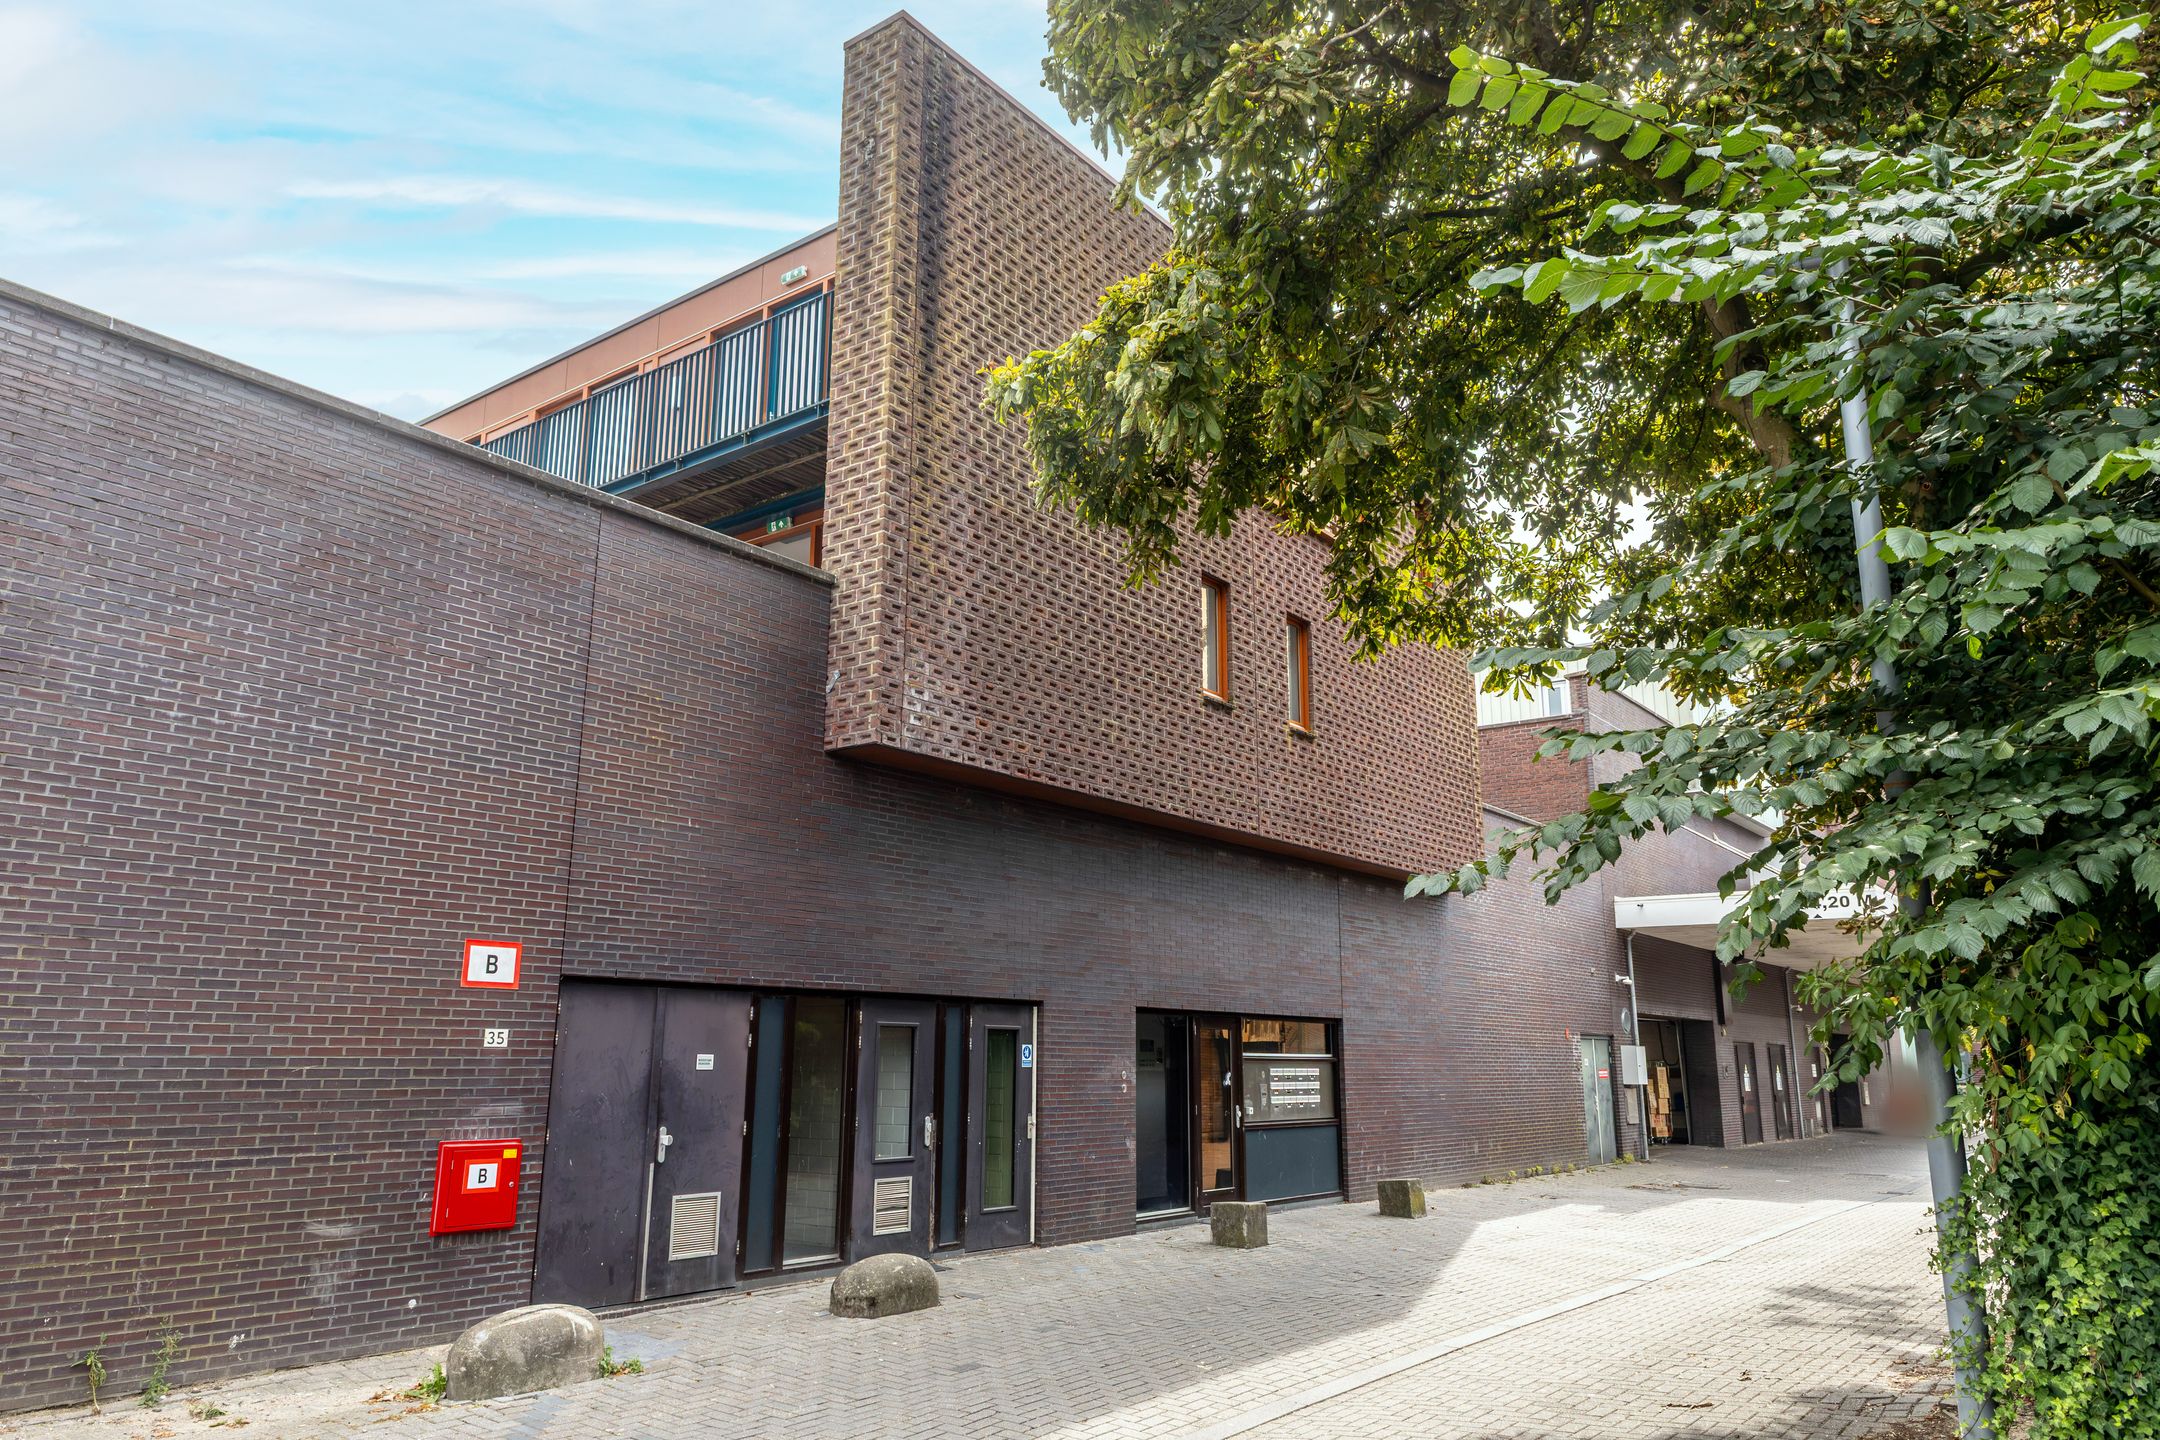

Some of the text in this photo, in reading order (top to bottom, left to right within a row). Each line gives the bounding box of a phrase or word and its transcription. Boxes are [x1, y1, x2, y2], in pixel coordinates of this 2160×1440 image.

[1816, 895, 1850, 911] ,20
[486, 954, 498, 974] B
[487, 1031, 504, 1045] 35
[478, 1168, 488, 1184] B
